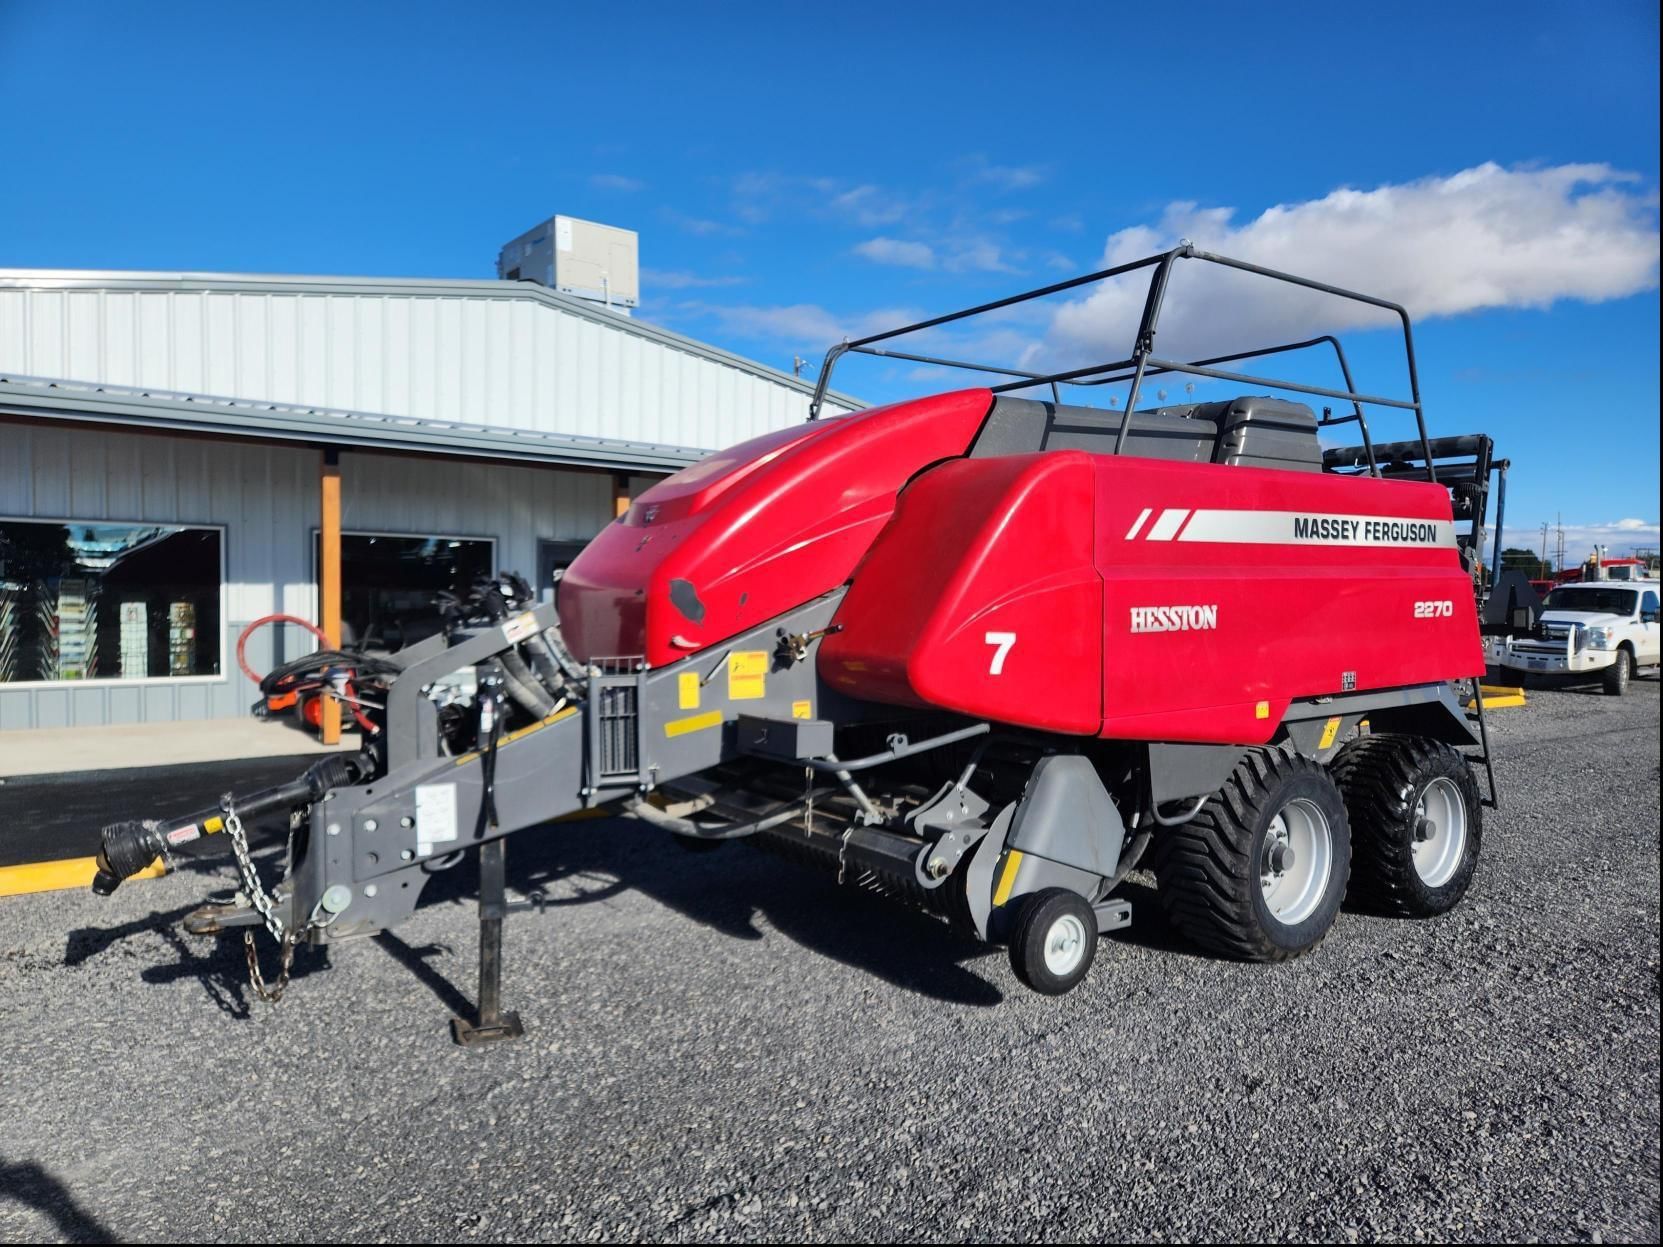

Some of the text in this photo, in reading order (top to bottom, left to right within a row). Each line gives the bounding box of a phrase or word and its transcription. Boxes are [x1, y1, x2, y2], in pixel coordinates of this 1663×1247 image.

[1294, 518, 1437, 543] MASSEY FERGUSON
[1130, 604, 1218, 633] HESSTON
[1414, 600, 1453, 618] 2270
[985, 631, 1017, 675] 7
